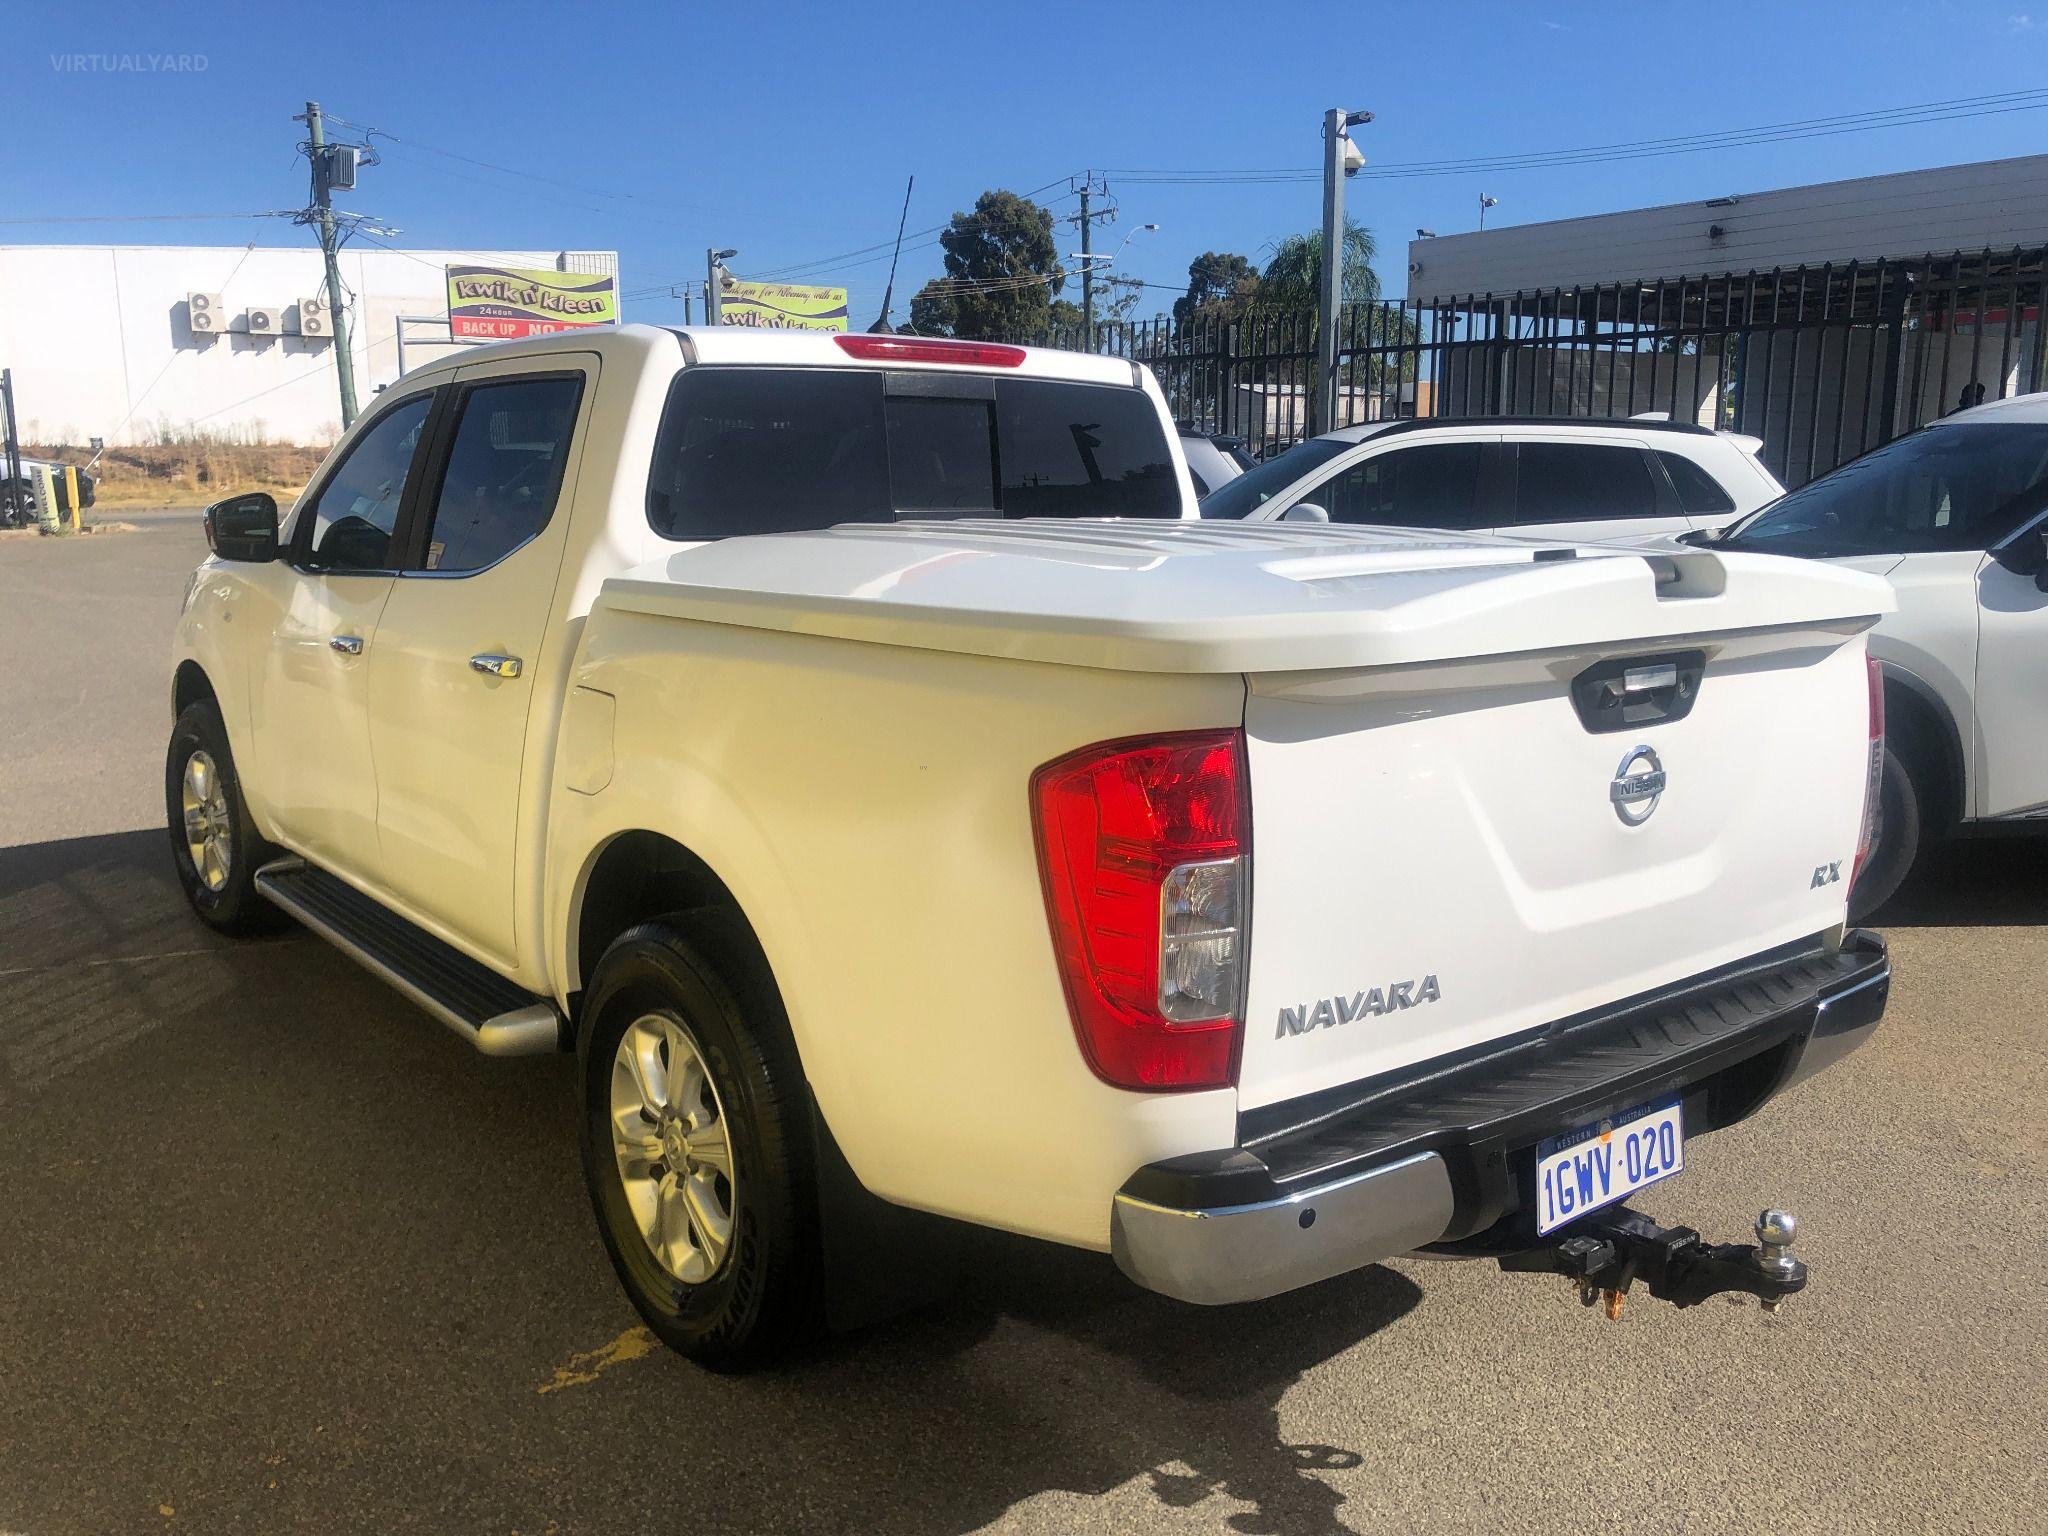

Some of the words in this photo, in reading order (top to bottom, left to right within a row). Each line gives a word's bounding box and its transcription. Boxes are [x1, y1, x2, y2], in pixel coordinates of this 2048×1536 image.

[456, 280, 518, 304] kwik
[540, 291, 606, 315] kleen
[480, 306, 492, 315] 24
[462, 321, 496, 335] BACK
[501, 323, 517, 336] UP
[1810, 859, 1843, 890] RX
[1274, 973, 1442, 1040] NAVARA
[1556, 1129, 1591, 1150] WESTERN
[1619, 1105, 1652, 1124] AUSTRALIA
